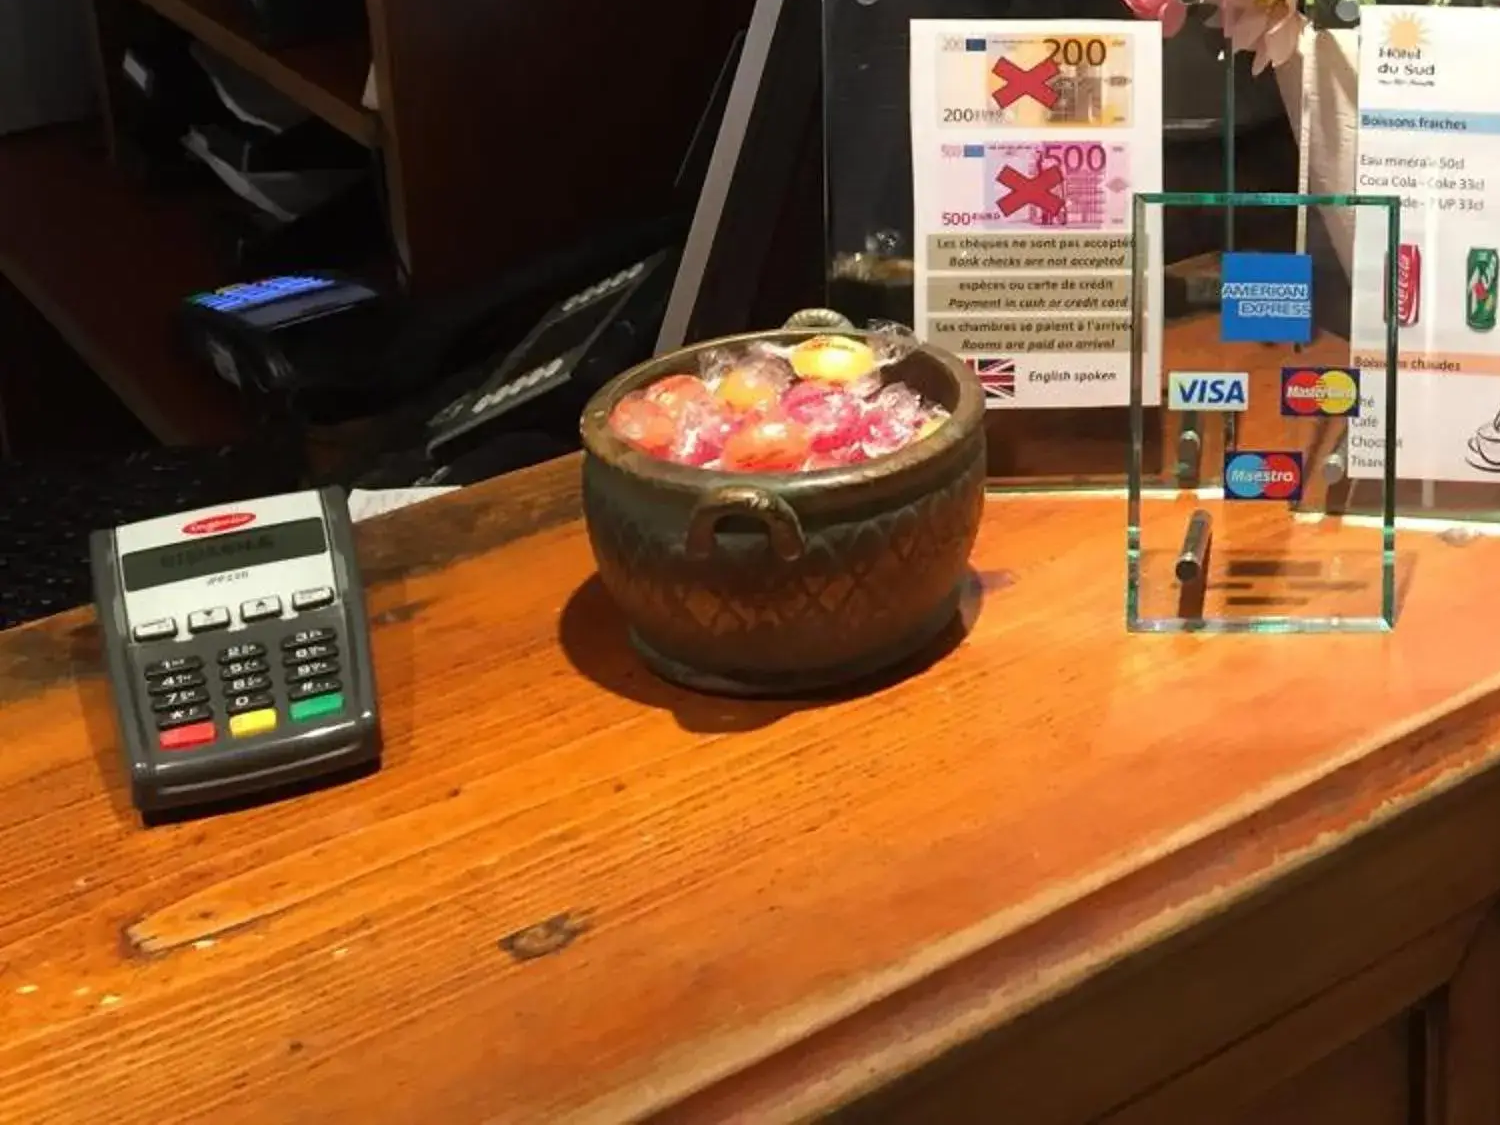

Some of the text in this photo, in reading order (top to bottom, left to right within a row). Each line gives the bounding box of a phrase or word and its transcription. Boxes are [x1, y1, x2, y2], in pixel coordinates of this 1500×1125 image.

[1041, 37, 1108, 68] 200
[1377, 63, 1437, 77] du Sud
[942, 107, 973, 123] 200
[1361, 114, 1417, 130] Boissons
[1042, 143, 1108, 173] 500
[1360, 154, 1465, 170] Eau minéra 50cl
[1359, 175, 1389, 187] Coca
[1391, 175, 1418, 188] Cola
[1459, 179, 1486, 192] 33cl
[1458, 199, 1485, 213] 33cl
[941, 212, 972, 227] 500
[937, 238, 957, 250] Les
[959, 237, 1009, 253] chèques
[1012, 240, 1027, 250] ne
[1030, 238, 1057, 250] sont
[1059, 240, 1081, 253] pas
[949, 255, 1125, 270] Bank checks are not accepted
[959, 279, 1114, 294] espèces ou carte de crédit
[1222, 283, 1309, 300] AMERICAN
[948, 297, 1129, 312] Payment in cash or credit card
[1238, 301, 1312, 319] EXPRESS
[936, 321, 957, 333] Les
[959, 321, 1018, 333] chambres
[1020, 323, 1033, 333] se
[961, 338, 1116, 353] Rooms are paid on arrival
[1028, 370, 1118, 383] English spoken
[1178, 379, 1246, 405] VISA
[1351, 415, 1379, 428] Café
[1351, 455, 1387, 468] Tisan
[1231, 468, 1296, 483] Maestro
